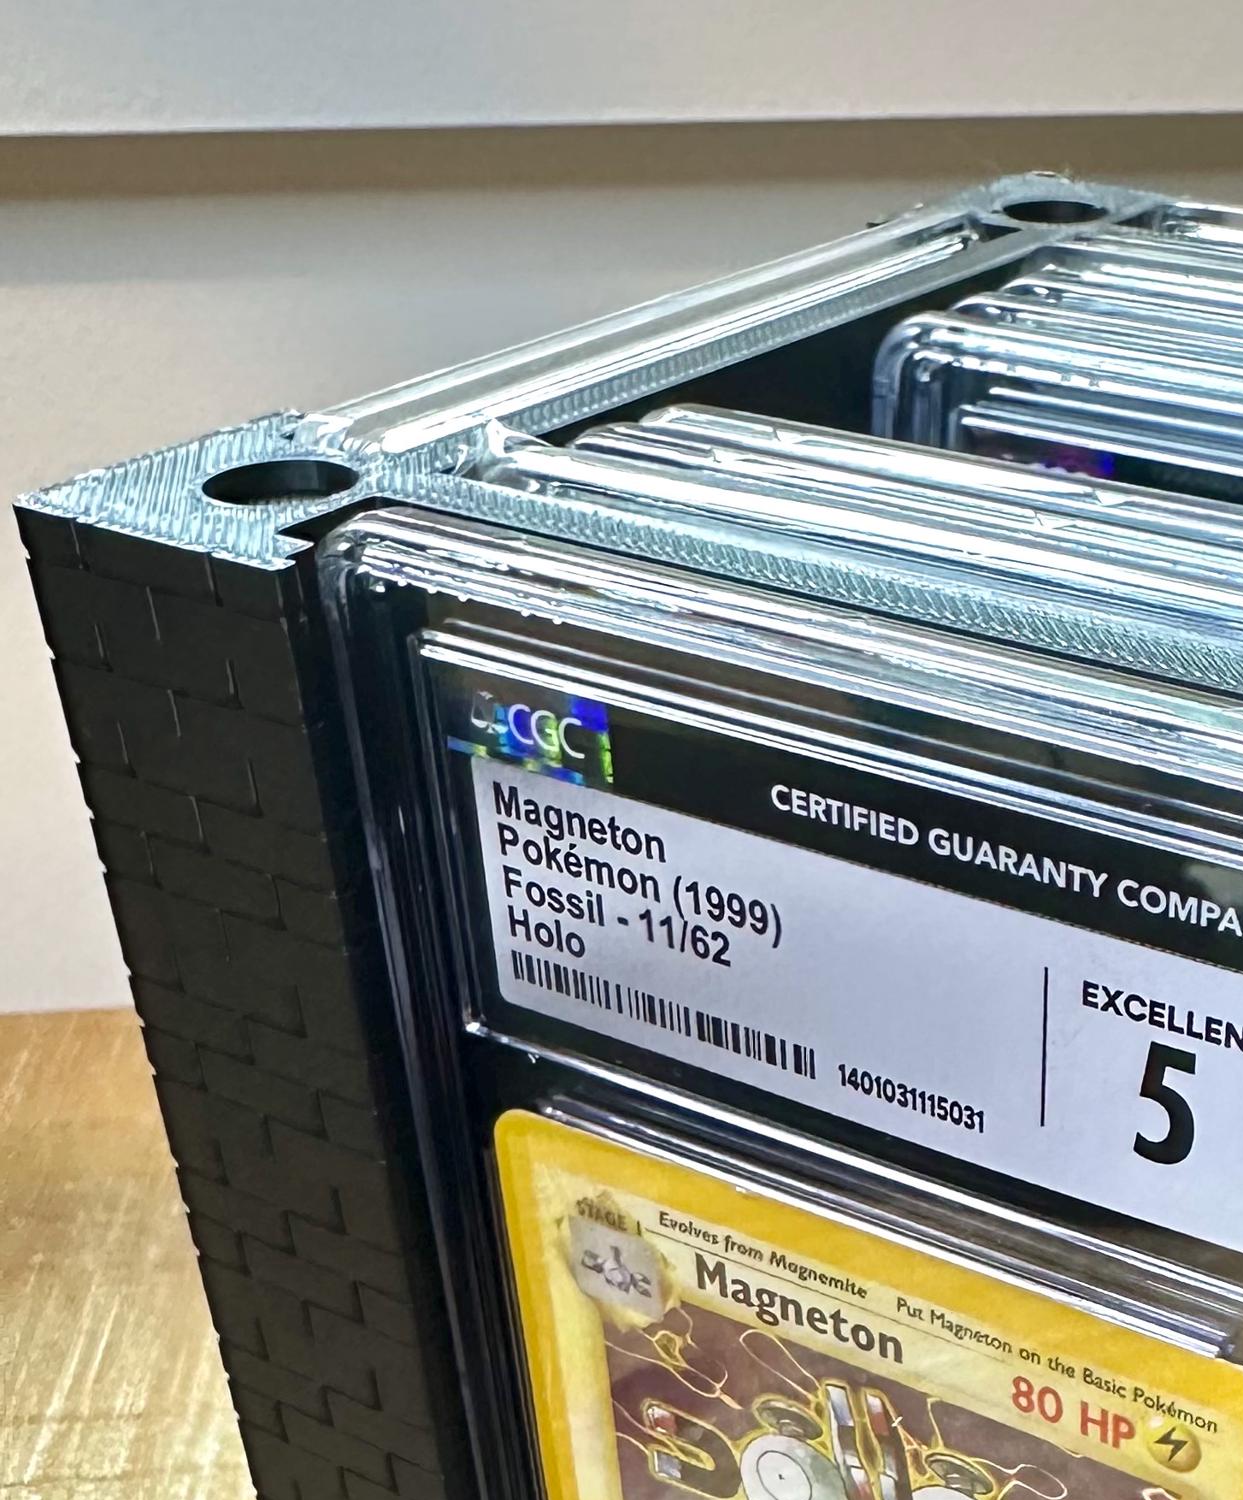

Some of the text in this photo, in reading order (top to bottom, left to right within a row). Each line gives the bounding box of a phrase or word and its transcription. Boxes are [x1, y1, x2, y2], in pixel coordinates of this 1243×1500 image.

[508, 703, 586, 759] CGC
[492, 781, 666, 862] Magneton
[770, 784, 919, 847] CERTIFIED
[928, 827, 1108, 897] GUARANTY
[497, 823, 782, 948] Pokémon (1999)
[502, 866, 605, 926] Fossil
[639, 910, 731, 967] 11/62
[507, 905, 586, 958] Holo
[837, 1064, 985, 1134] 1401031115031
[1133, 1041, 1196, 1164] 5
[577, 1201, 627, 1231] STAGE
[660, 1211, 719, 1244] Evolves
[725, 1235, 763, 1261] from
[770, 1252, 867, 1298] Magnemite
[897, 1297, 923, 1320] Put
[1020, 1349, 1040, 1364] on
[1048, 1357, 1075, 1378] the
[1083, 1368, 1126, 1398] Basic
[1133, 1387, 1217, 1433] Pokémon
[695, 1252, 902, 1363] Magneton
[1012, 1376, 1135, 1448] 80 HP
